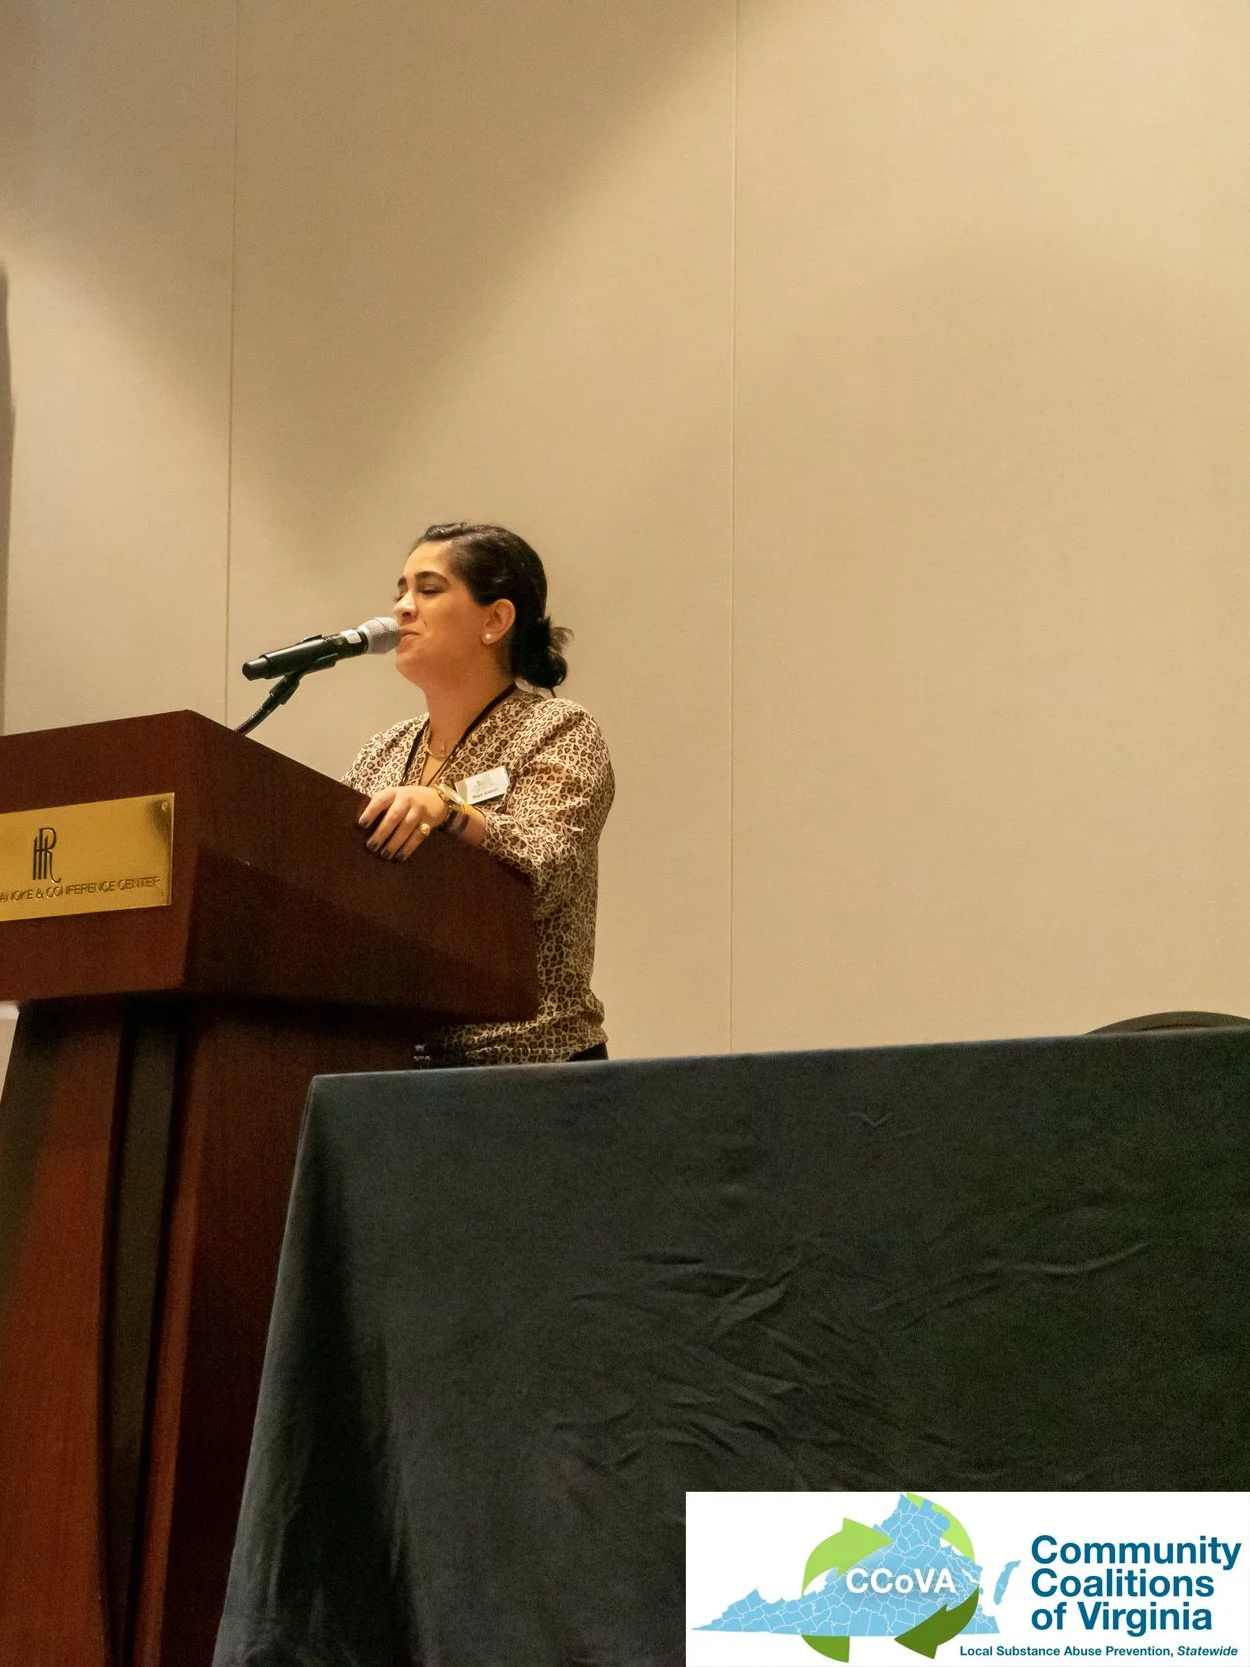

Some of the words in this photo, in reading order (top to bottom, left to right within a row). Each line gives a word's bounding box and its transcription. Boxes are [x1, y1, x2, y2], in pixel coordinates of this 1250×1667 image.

[36, 887, 44, 899] &
[46, 880, 115, 898] CONFERENCE
[118, 876, 160, 891] CENTER
